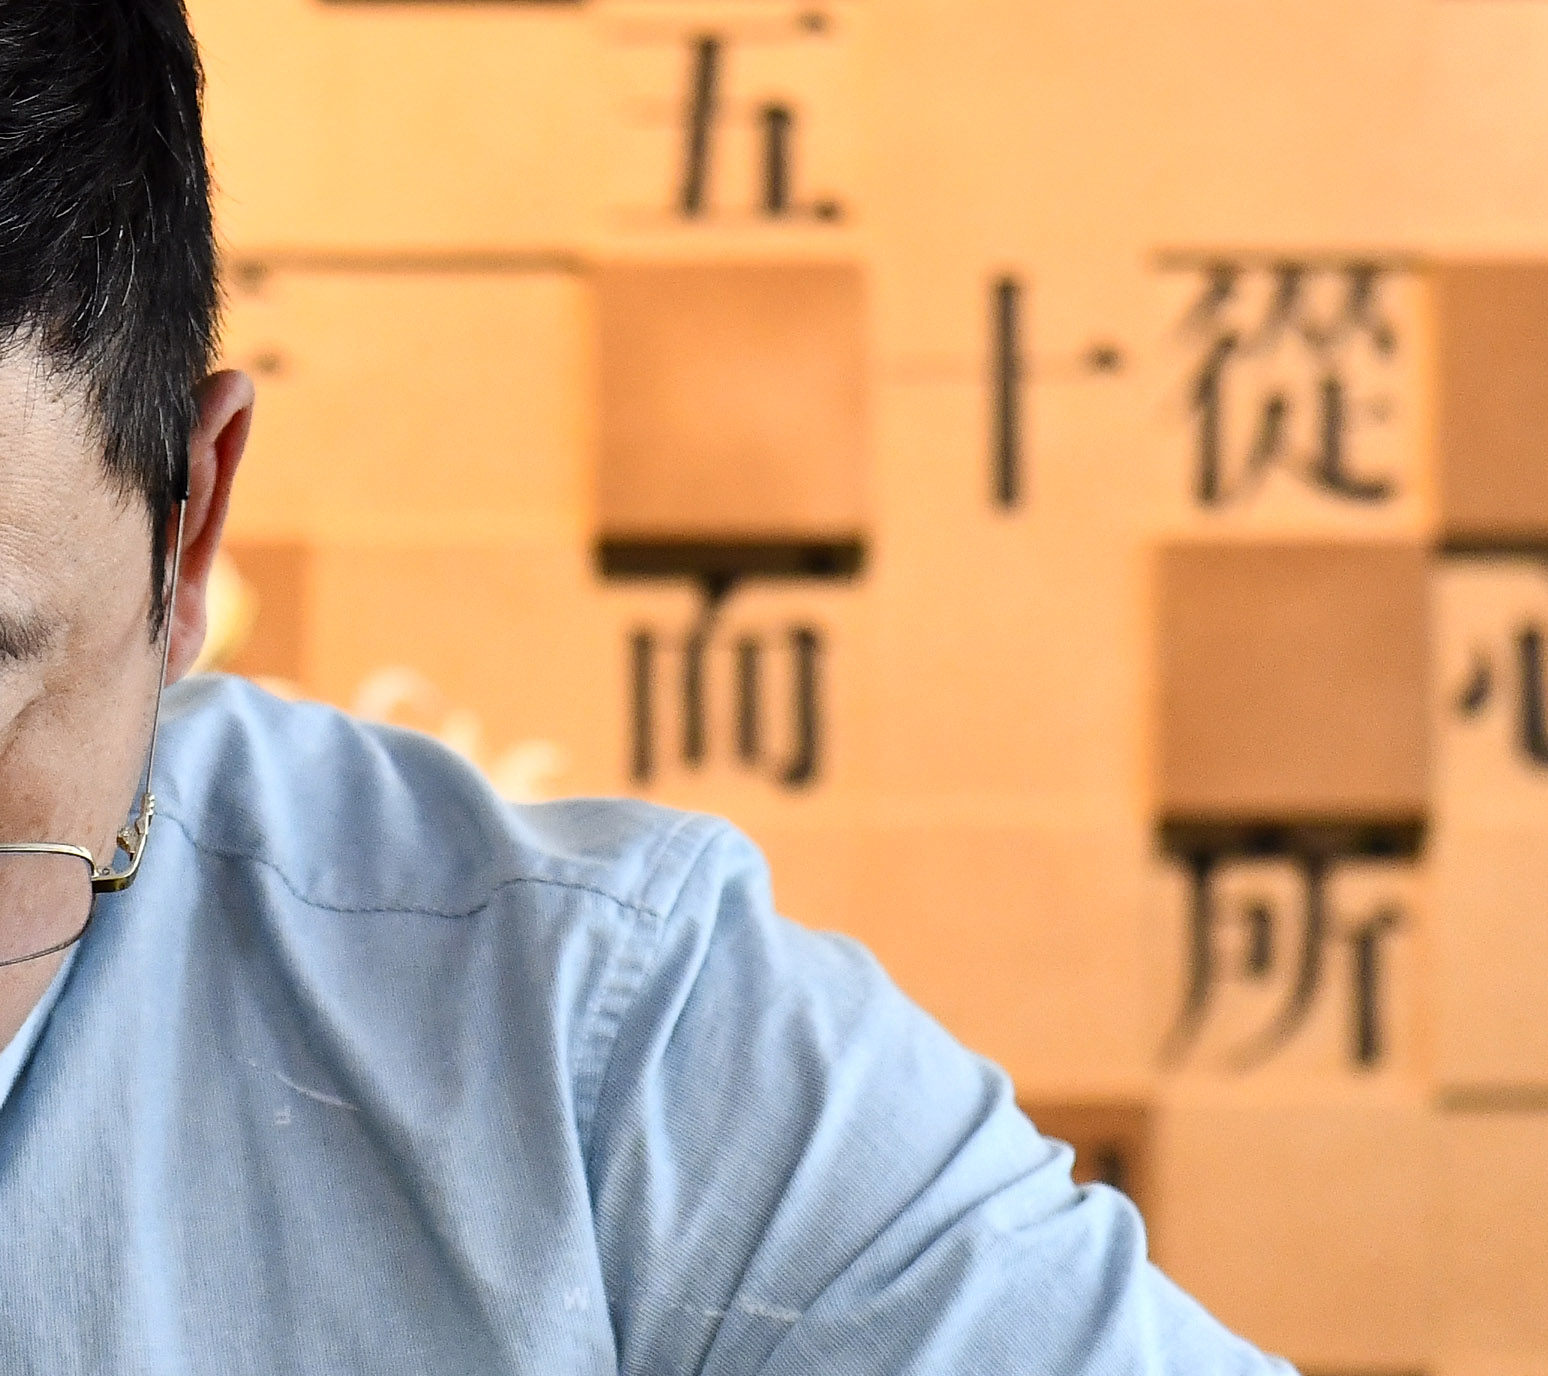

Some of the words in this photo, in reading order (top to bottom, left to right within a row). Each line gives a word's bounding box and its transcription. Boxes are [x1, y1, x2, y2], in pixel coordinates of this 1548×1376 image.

[601, 11, 848, 224] 五
[879, 272, 1129, 512] 十
[1176, 257, 1404, 511] 從
[607, 552, 839, 792] 而
[1156, 826, 1412, 1074] 所
